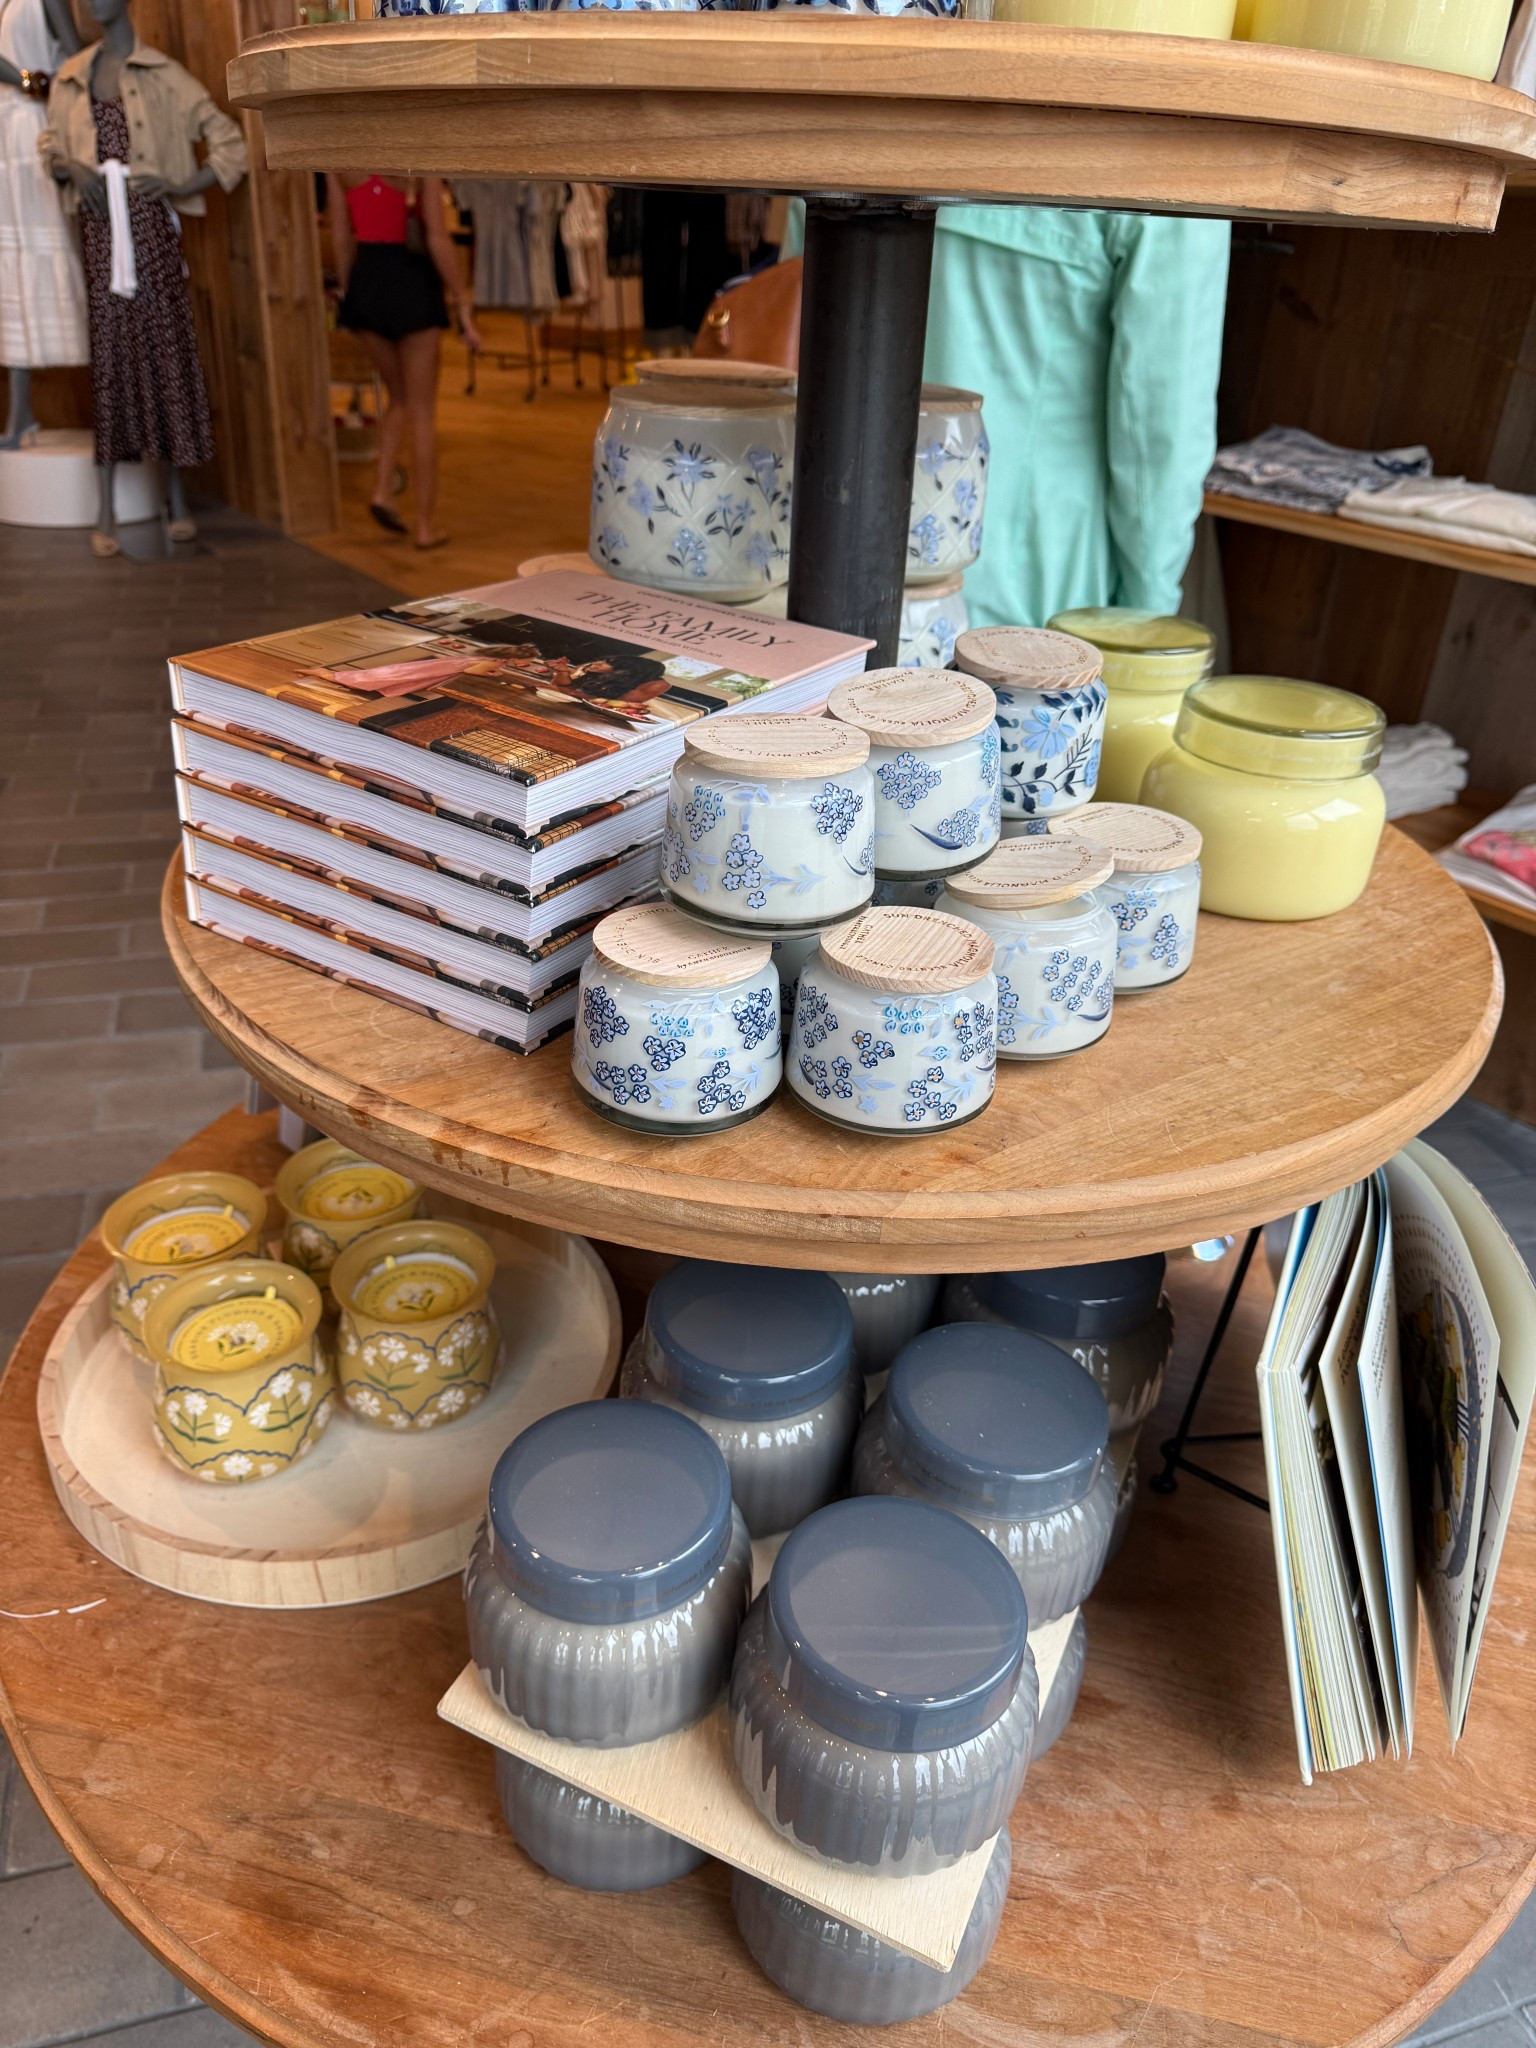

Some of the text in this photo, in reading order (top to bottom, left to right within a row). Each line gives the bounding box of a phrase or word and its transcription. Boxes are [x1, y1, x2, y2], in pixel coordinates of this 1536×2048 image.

[575, 591, 795, 648] THE FAMILY
[591, 610, 716, 645] HOME
[983, 878, 1049, 889] MAGNOLIA
[913, 913, 972, 939] DRENCHED
